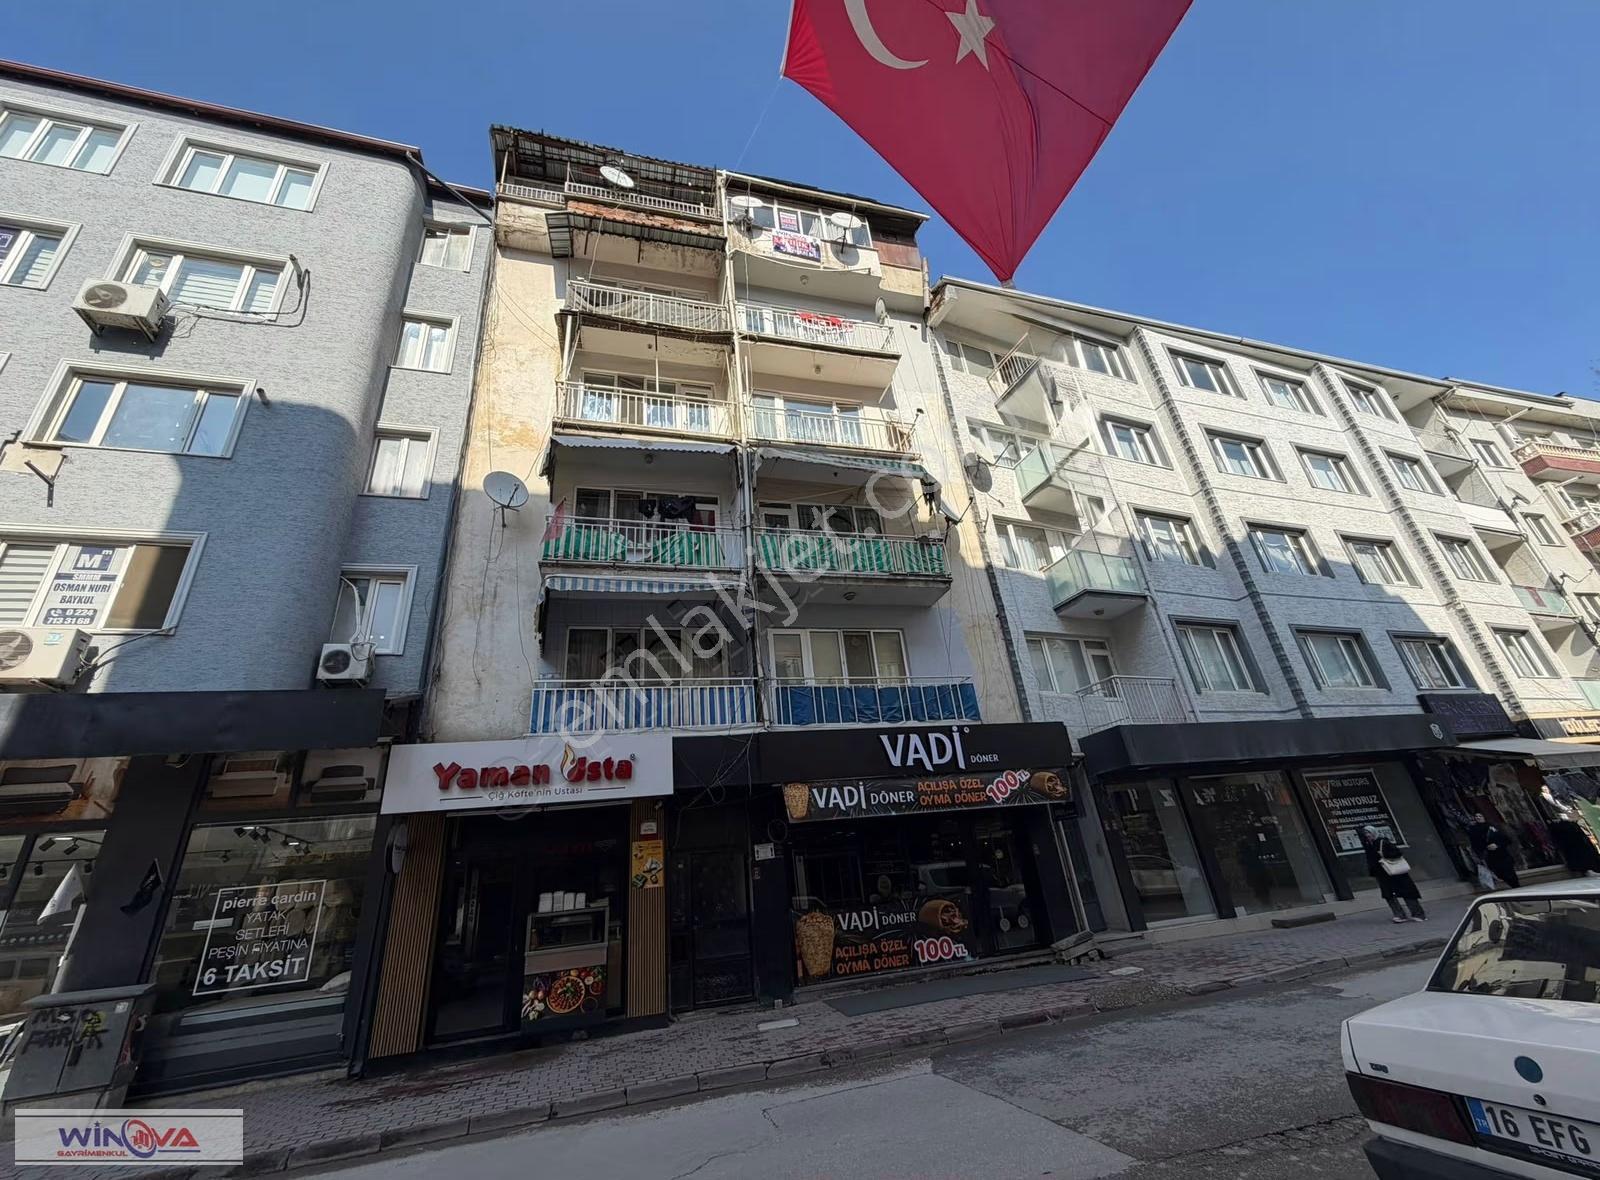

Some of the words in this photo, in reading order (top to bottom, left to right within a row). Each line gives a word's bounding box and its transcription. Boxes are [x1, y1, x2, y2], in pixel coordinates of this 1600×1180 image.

[53, 582, 88, 592] OSMAN
[87, 583, 112, 593] NURİ
[59, 595, 96, 605] BAYKUL
[47, 616, 65, 625] 713
[76, 617, 91, 625] 68
[74, 609, 95, 617] 224
[970, 753, 1000, 764] DÖNER
[432, 761, 550, 791] Yaman
[917, 781, 957, 795] AÇILIŞA
[959, 777, 985, 790] ÖZEL
[487, 791, 505, 801] Çiğ
[554, 787, 583, 796] Ustası
[811, 781, 867, 811] VADİ
[870, 790, 915, 806] DÖNER
[920, 795, 954, 807] OYMA
[954, 792, 988, 804] DÖNER
[1321, 795, 1380, 810] TAŞINIYORUZ
[221, 896, 268, 912] pierre
[271, 890, 317, 904] cardin
[246, 911, 287, 923] YATAK
[881, 911, 917, 926] DÖNER
[235, 924, 290, 941] SETLERİ
[207, 943, 249, 959] PEŞİN
[835, 942, 878, 961] AÇILIŞA
[880, 938, 907, 952] ÖZEL
[203, 967, 218, 986] 6
[223, 954, 305, 983] TAKSİT
[836, 961, 871, 975] OYMA
[874, 953, 910, 969] DÖNER
[1485, 1105, 1520, 1138] 16
[1528, 1114, 1591, 1155] EFG
